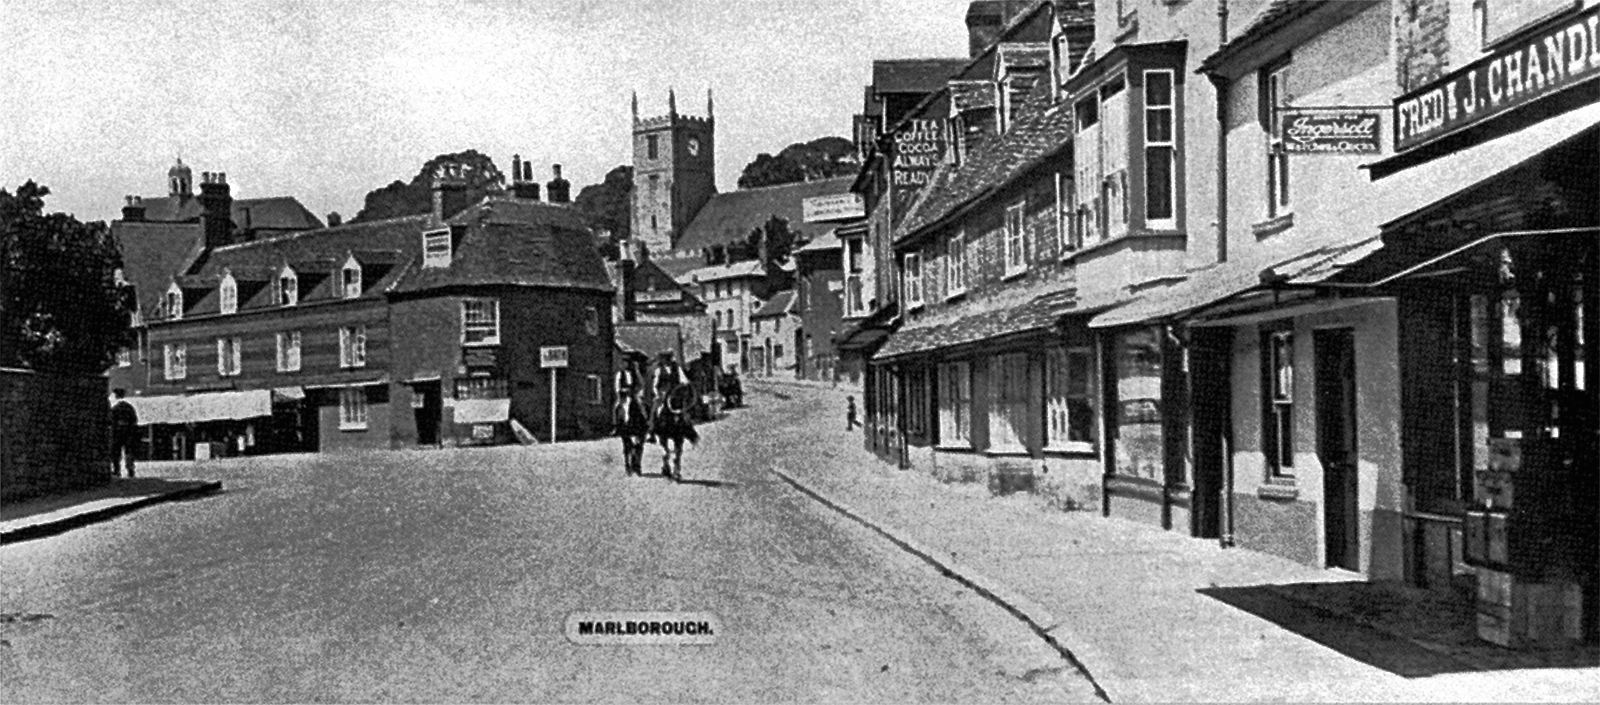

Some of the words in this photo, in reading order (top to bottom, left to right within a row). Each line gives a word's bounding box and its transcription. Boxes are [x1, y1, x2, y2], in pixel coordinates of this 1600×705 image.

[909, 119, 939, 130] TEA
[1287, 117, 1376, 142] Ingersoll
[894, 131, 938, 143] COFFEE
[899, 142, 938, 154] COCOA
[893, 153, 939, 167] ALWAYS
[894, 170, 932, 185] READY
